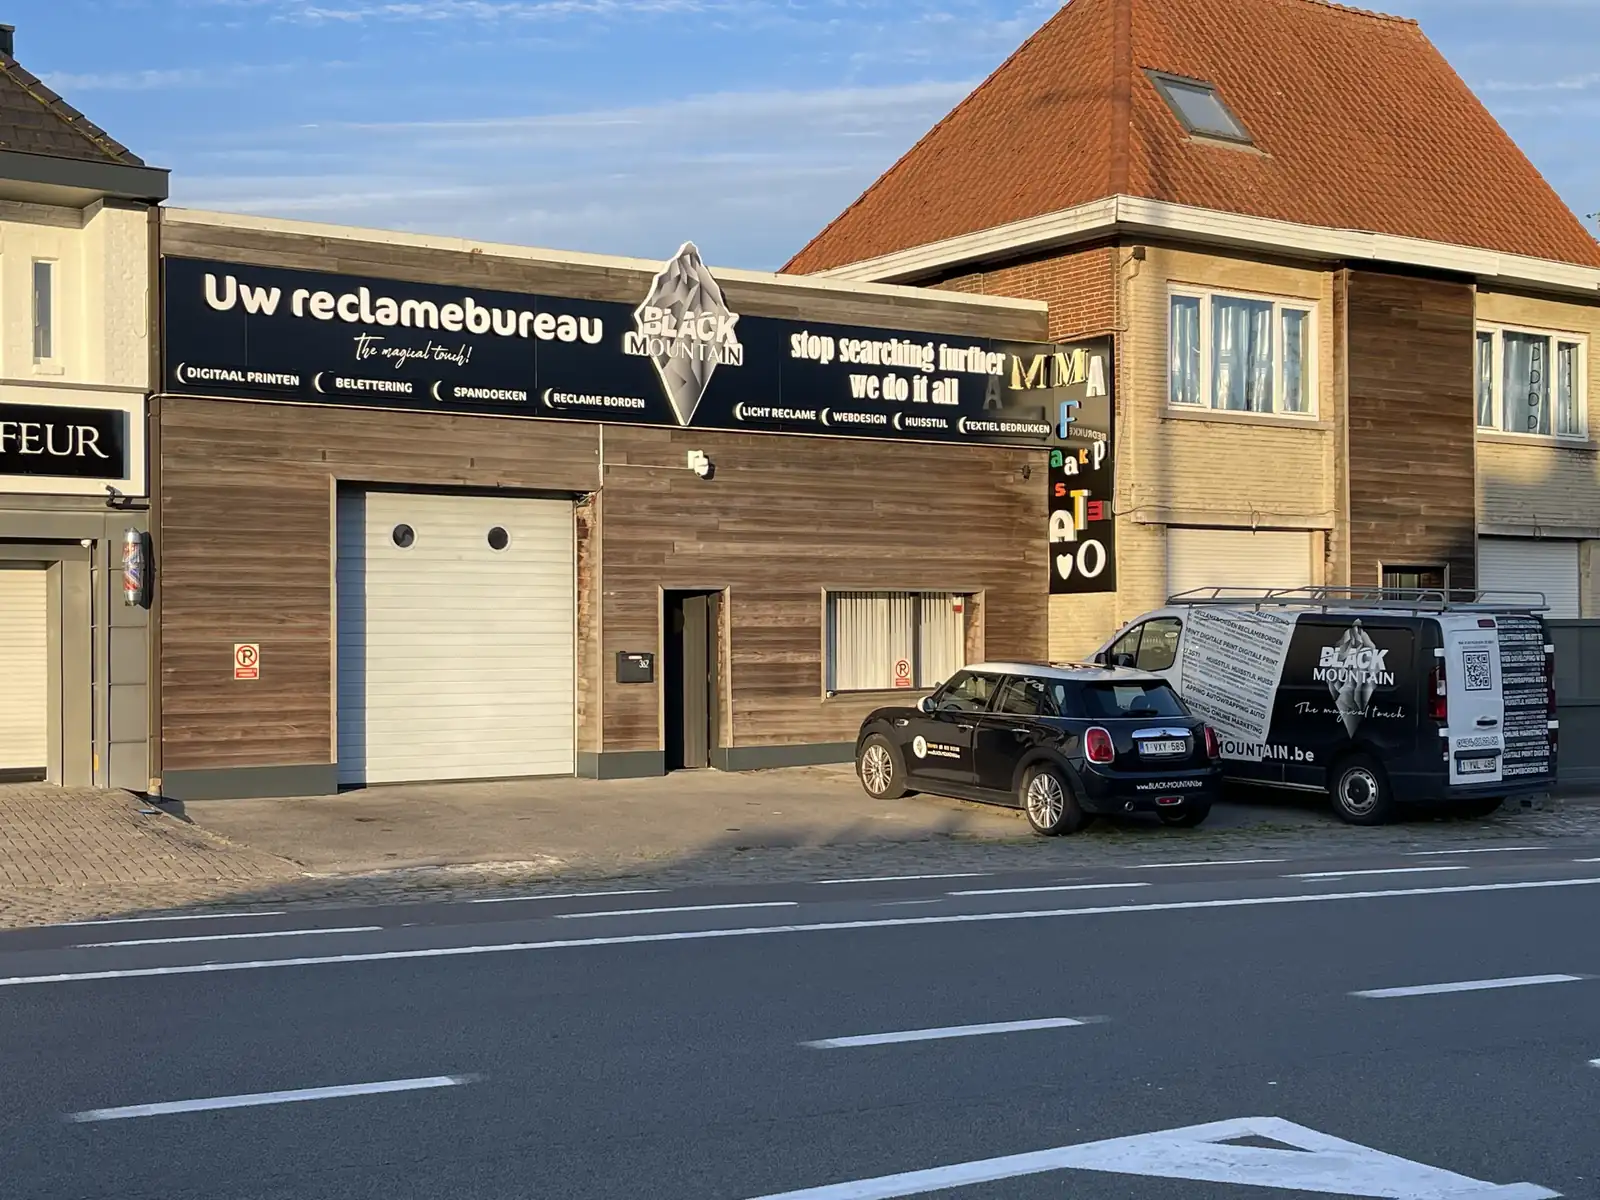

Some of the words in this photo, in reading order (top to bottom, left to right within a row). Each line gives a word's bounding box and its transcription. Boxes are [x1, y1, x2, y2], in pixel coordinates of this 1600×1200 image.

[204, 273, 282, 316] Uw
[291, 286, 604, 344] reclamebureau
[643, 305, 740, 344] BLACK
[354, 332, 385, 361] The
[381, 339, 433, 369] magical
[430, 343, 473, 367] touch!
[627, 334, 742, 366] MOUNTAIN
[789, 330, 835, 365] stop
[838, 337, 935, 373] searching
[938, 343, 1006, 376] further
[186, 366, 246, 382] DIGITAAL
[247, 371, 300, 387] PRINTEN
[335, 377, 413, 394] BELETTERING
[454, 386, 527, 402] SPANDOEKEN
[849, 373, 880, 400] we
[882, 372, 909, 401] do
[911, 374, 929, 403] it
[931, 377, 959, 406] all
[553, 392, 602, 406] RECLAME
[603, 395, 645, 409] BORDEN
[742, 405, 770, 418] LICHT
[771, 408, 816, 420] RECLAME
[832, 411, 887, 425] WEBDESIGN
[905, 416, 949, 429] HUISSTIJL
[965, 419, 999, 432] TEXTIEL
[1000, 421, 1050, 434] BEDRUKKEN
[0, 421, 109, 459] FEUR
[1237, 624, 1284, 646] RECLAMEBORDEN
[1319, 646, 1389, 671] BLACK
[1313, 667, 1395, 686] MOUNTAIN
[1211, 709, 1232, 720] ONLINE
[1231, 716, 1263, 735] MARKETING
[1249, 710, 1266, 720] AUTO
[1295, 701, 1318, 715] The
[1323, 705, 1369, 723] magical
